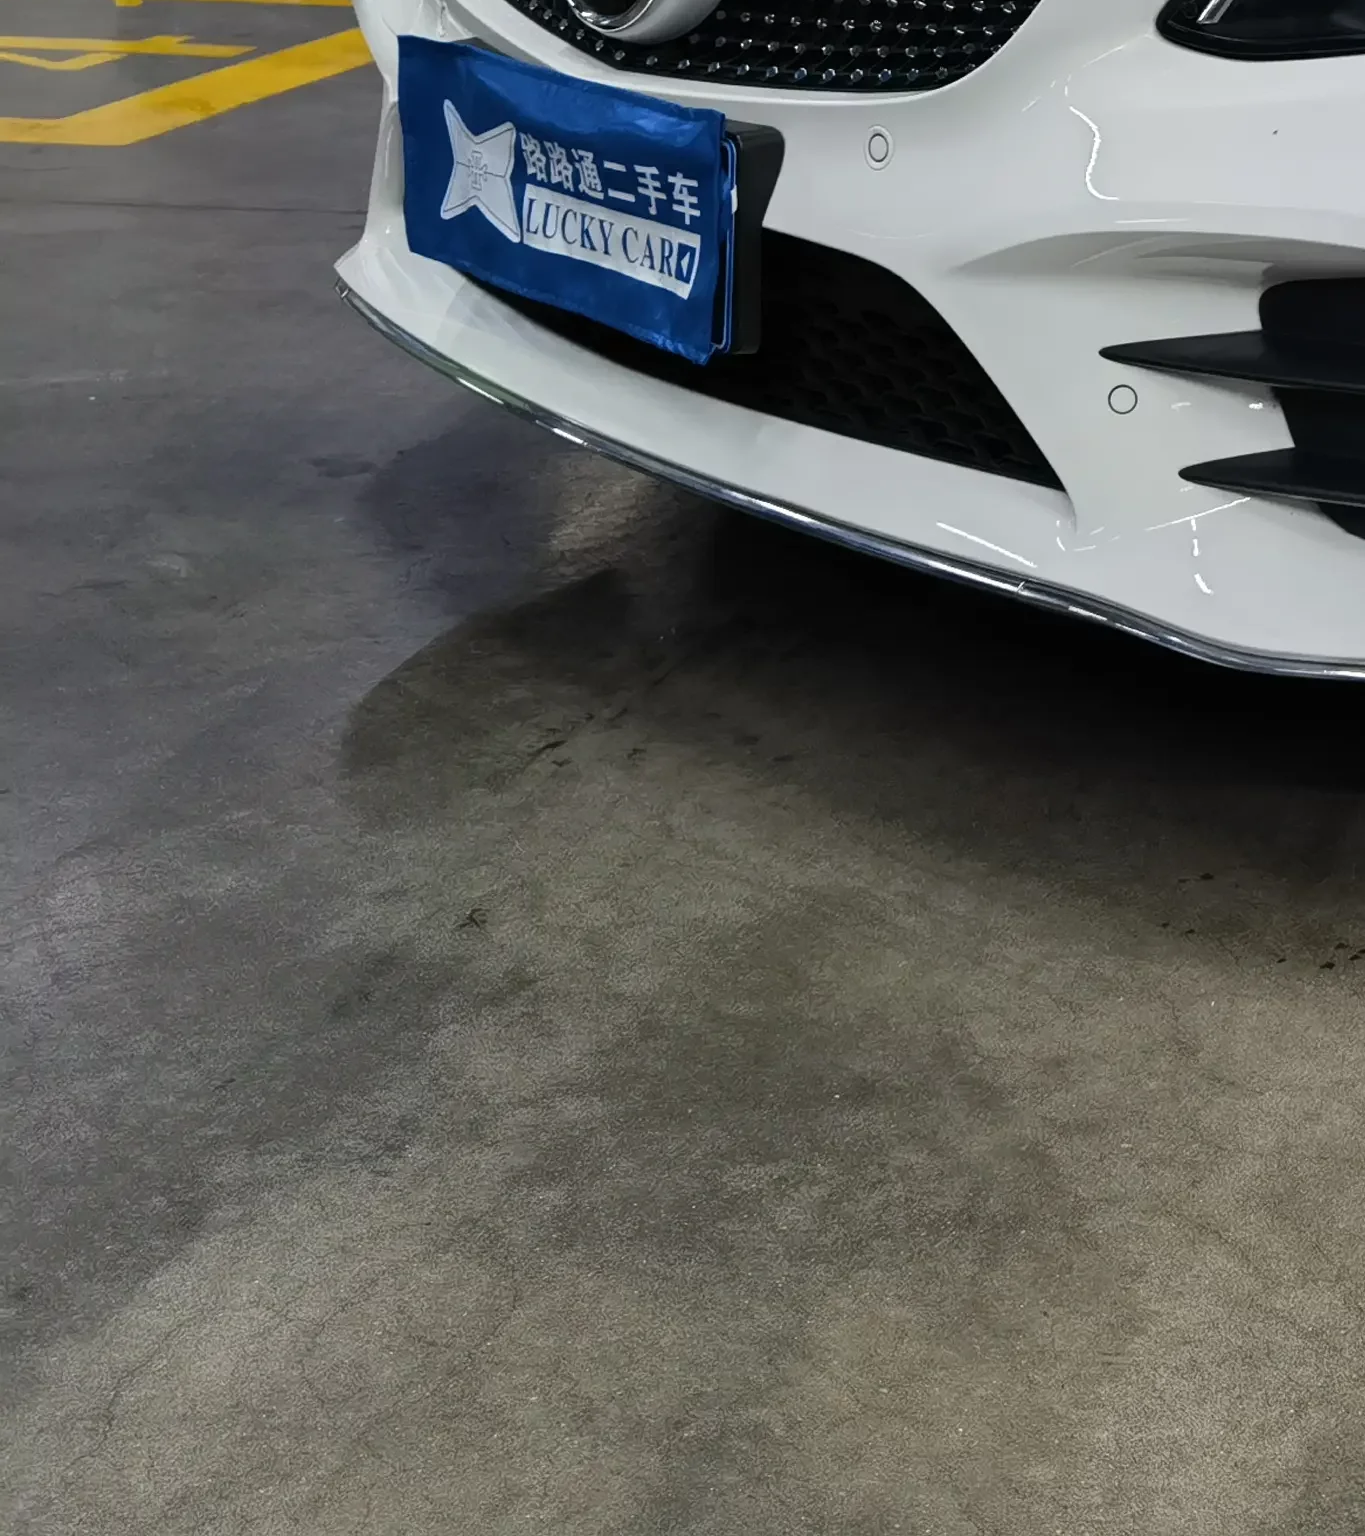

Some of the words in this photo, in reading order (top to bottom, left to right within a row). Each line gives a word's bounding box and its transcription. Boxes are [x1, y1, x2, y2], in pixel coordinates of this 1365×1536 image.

[519, 132, 701, 225] 路路通二手车
[525, 198, 614, 257] LUCKY
[621, 227, 673, 277] CAR
